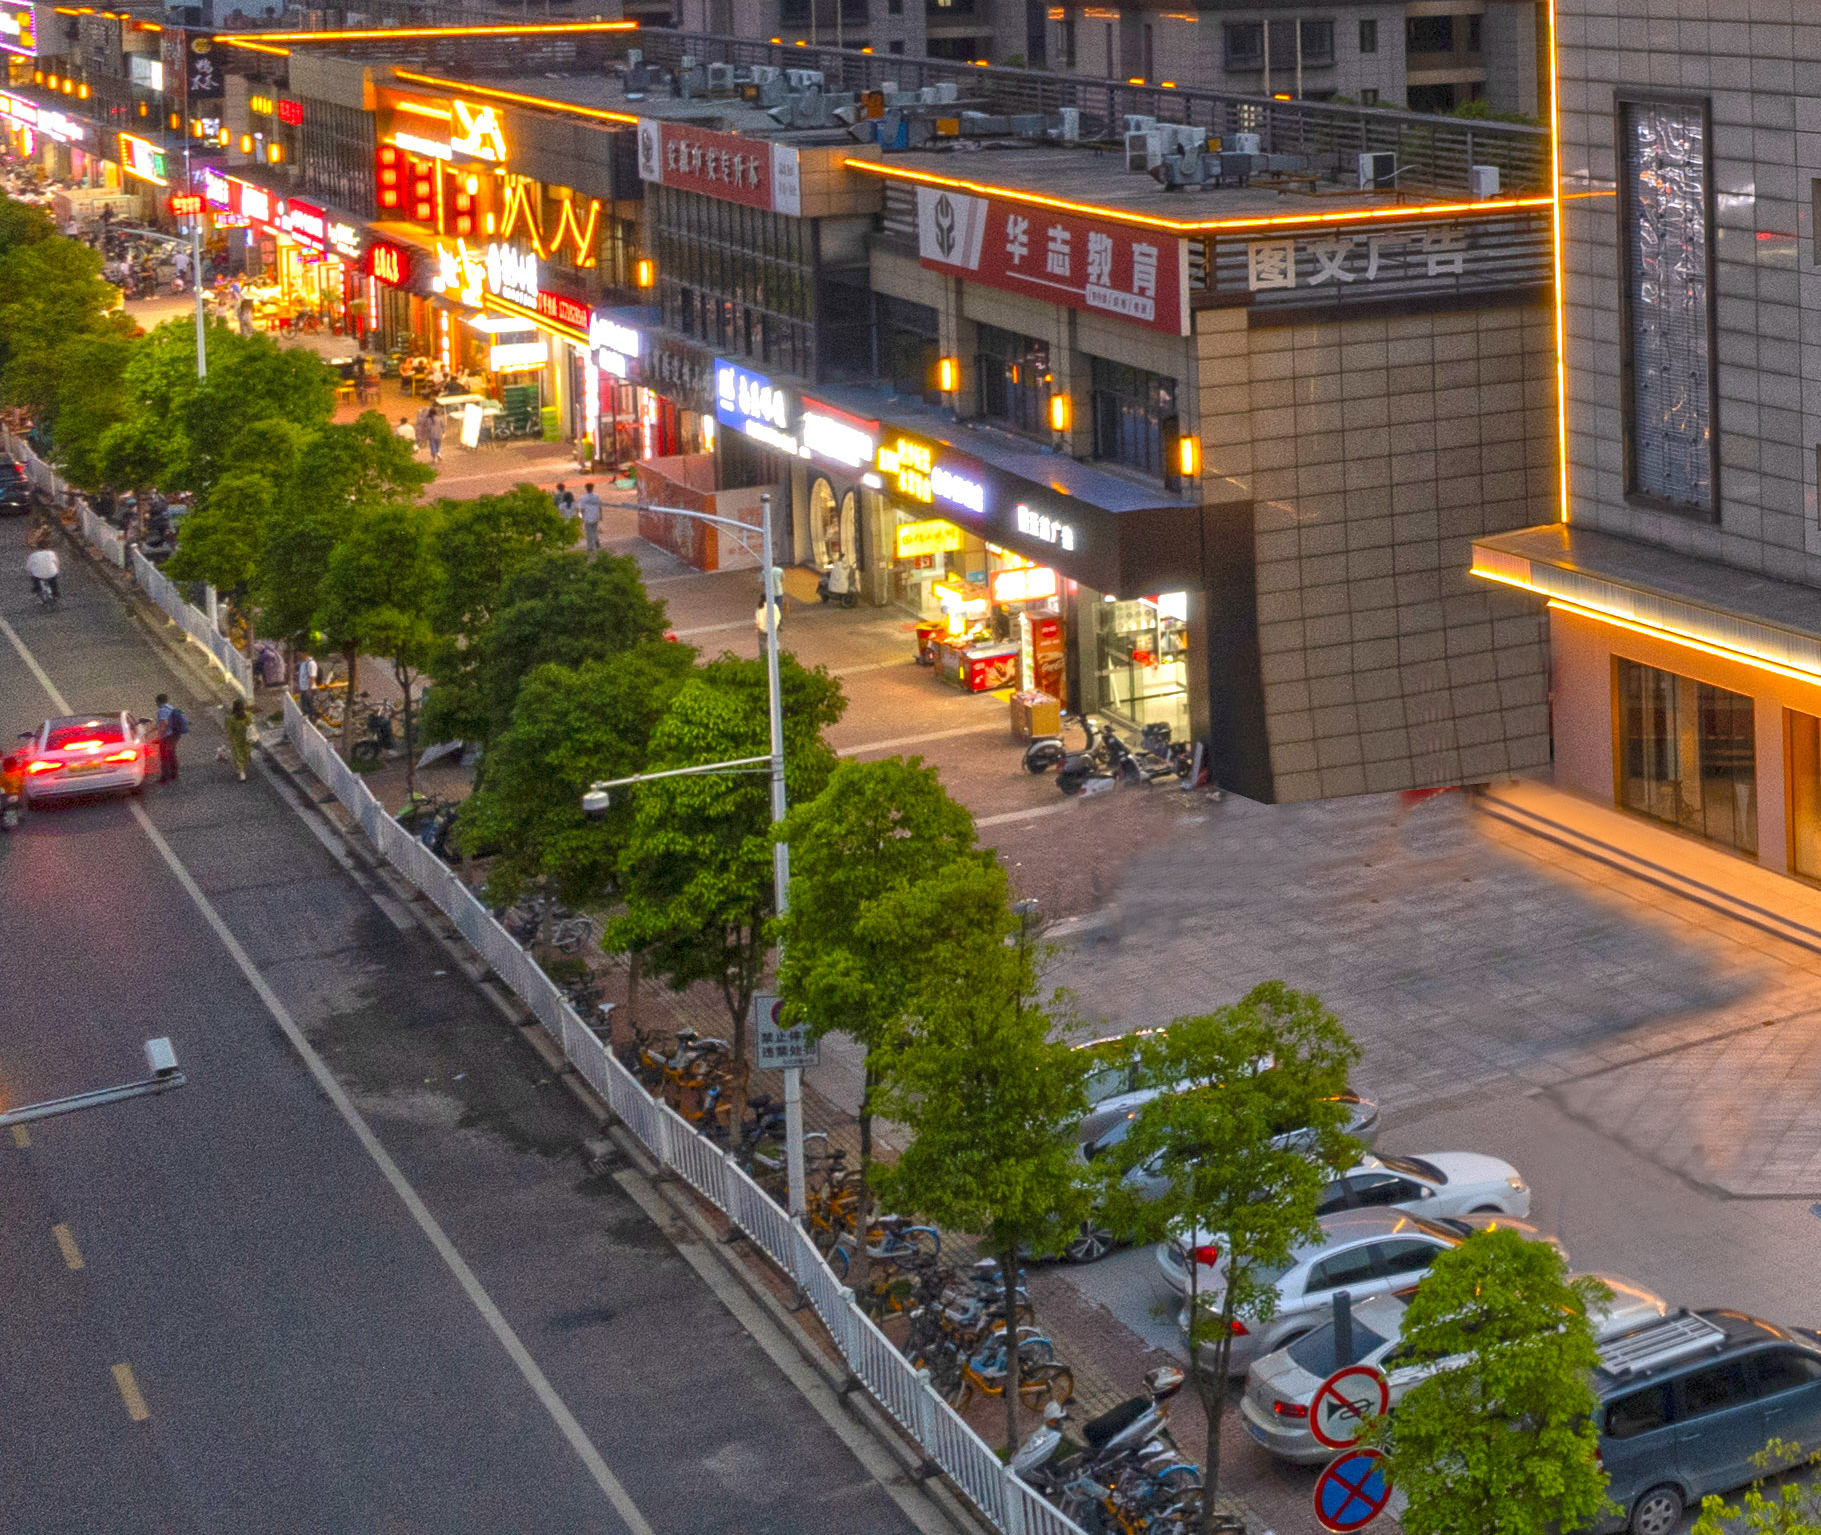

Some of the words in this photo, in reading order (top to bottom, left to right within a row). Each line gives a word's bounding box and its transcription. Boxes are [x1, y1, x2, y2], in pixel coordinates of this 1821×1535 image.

[1005, 213, 1159, 298] 华志教育
[1247, 225, 1468, 291] 图文广告
[761, 1031, 812, 1043] 禁止停
